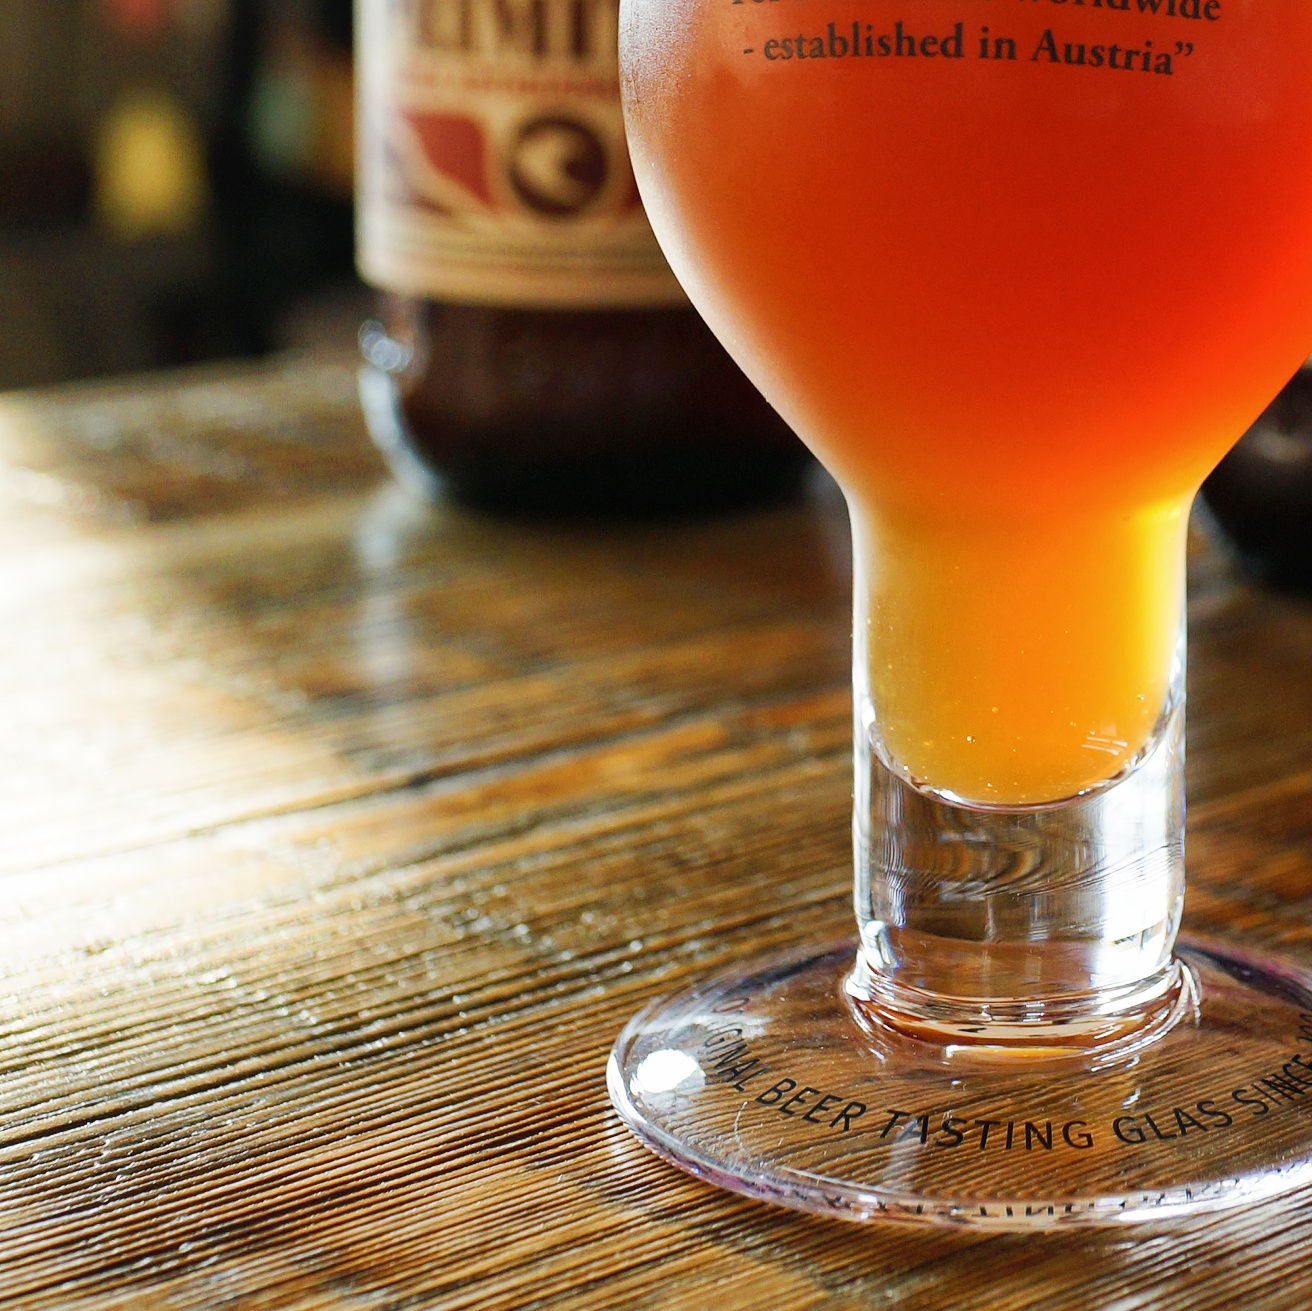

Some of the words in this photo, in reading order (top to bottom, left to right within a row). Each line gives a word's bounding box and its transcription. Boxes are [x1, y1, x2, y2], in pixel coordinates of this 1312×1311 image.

[763, 21, 966, 62] established
[978, 25, 1018, 62] in
[755, 1077, 867, 1131] BEER
[878, 1109, 1095, 1151] TASTING
[1111, 1100, 1233, 1145] GLAS
